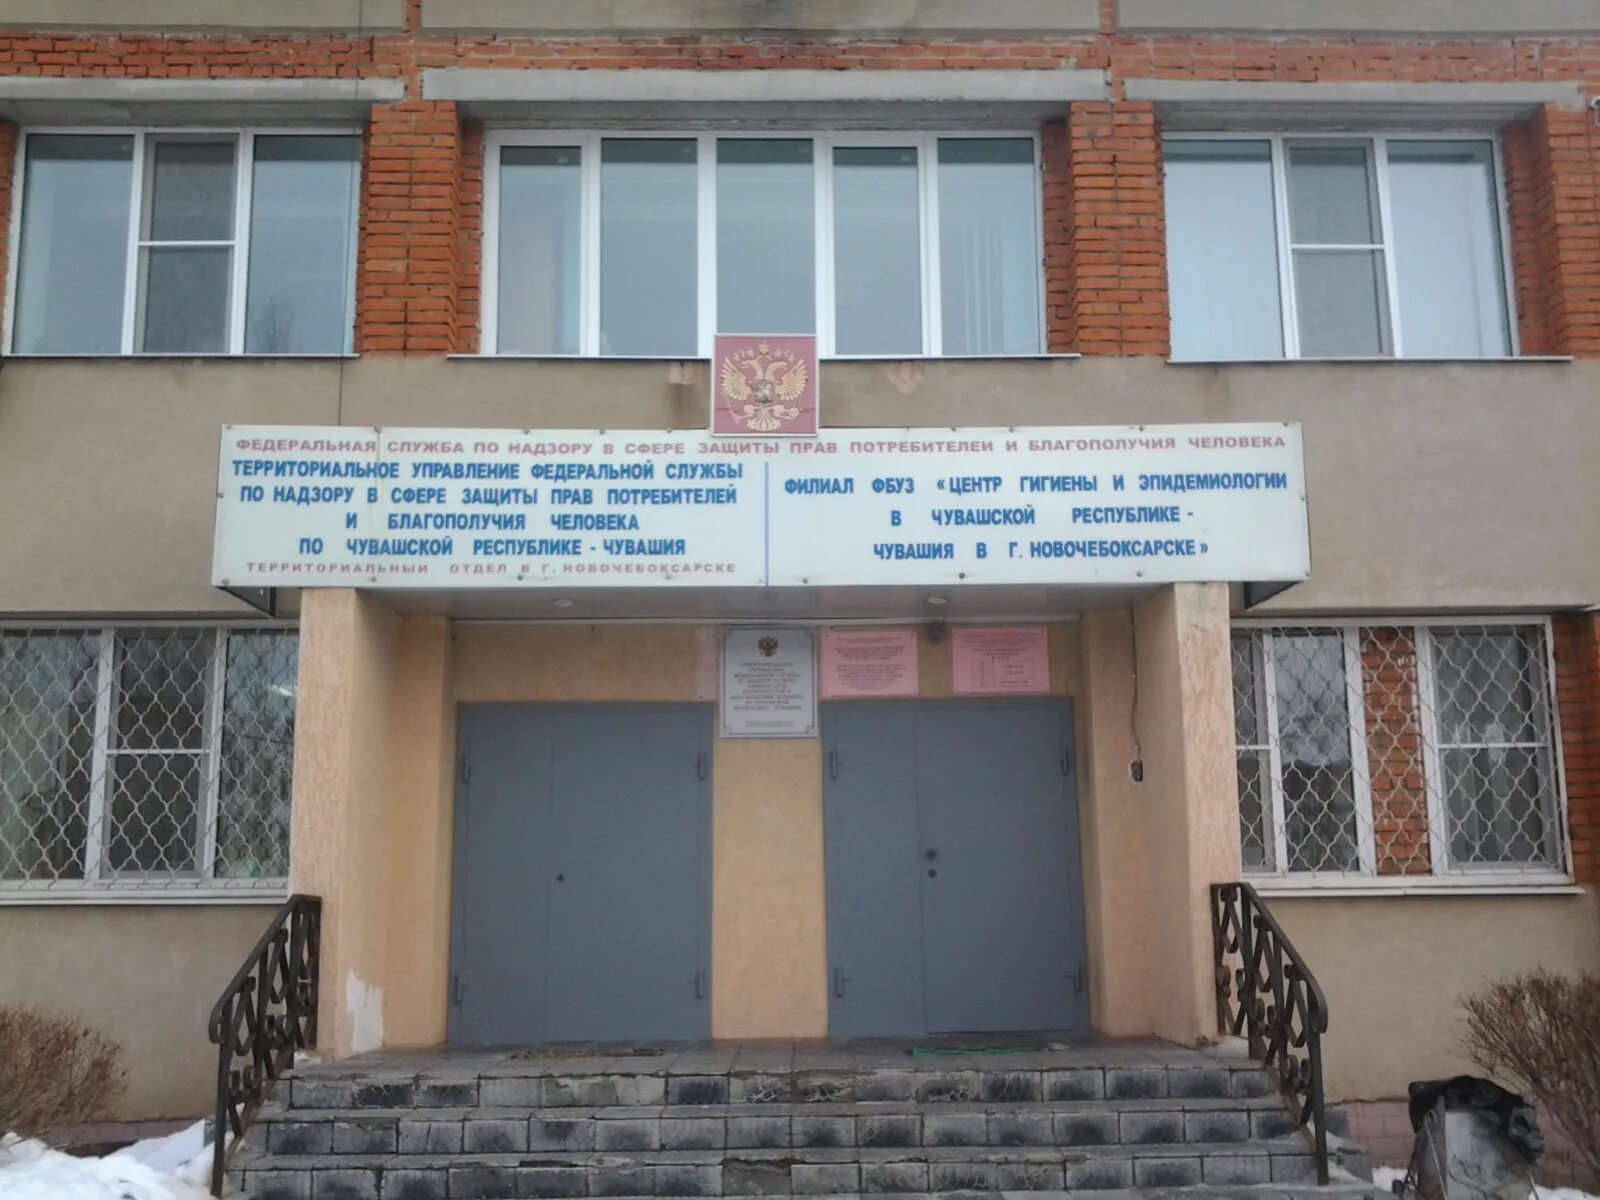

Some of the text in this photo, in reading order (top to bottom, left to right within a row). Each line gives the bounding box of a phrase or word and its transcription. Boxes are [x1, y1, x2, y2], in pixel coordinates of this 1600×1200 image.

[235, 438, 377, 453] ФЕДЕРАЛЬНАЯ
[387, 441, 464, 453] СЛУЖБА
[474, 442, 499, 453] ПО
[508, 443, 592, 456] НАДЗОРУ
[603, 444, 614, 454] В
[625, 443, 684, 454] СФЕРЕ
[699, 442, 780, 455] ЗАЩИТЫ
[788, 441, 838, 453] ПРАВ
[1006, 441, 1018, 451] И
[1029, 439, 1176, 451] БЛАГОПОЛУЧИЯ
[1188, 437, 1285, 448] ЧЕЛОВЕКА
[232, 460, 742, 482] ТЕРРИТОРИАЛЬНОЕ УПРАВЛЕНИЕ ФЕДЕРАЛЬНОЙ СЛУЖБЫ
[785, 478, 853, 494] ФИЛИАЛ
[872, 478, 914, 494] ФБУЗ
[1020, 476, 1097, 492] ГИГИЕНЫ
[1113, 475, 1124, 490] И
[1139, 473, 1287, 492] ЭПИДЕМИОЛОГИИ
[241, 484, 736, 506] ПО НАДЗОРУ В СФЕРЕ ЗАЩИТЫ ПРАВ ПОТРЕБИТЕЛЕЙ
[346, 513, 639, 530] И БЛАГОПОЛУЧИЯ ЧЕЛОВЕКА
[891, 510, 902, 526] В
[932, 505, 1035, 525] ЧУВАШСКОЙ
[1072, 506, 1180, 523] РЕСПУБЛИКЕ
[300, 538, 323, 555] ПО
[347, 536, 452, 555] ЧУВАШСКОЙ
[474, 539, 581, 555] РЕСПУБЛИКЕ
[603, 539, 685, 555] ЧУВАШИЯ
[874, 543, 953, 559] ЧУВАШИЯ
[976, 542, 987, 558] В
[1009, 542, 1021, 558] Г.
[450, 564, 506, 574] ОТДЕЛ
[522, 563, 530, 573] В
[542, 563, 557, 573] Г.
[563, 563, 735, 573] НОВОЧЕБОКСАРСКЕ
